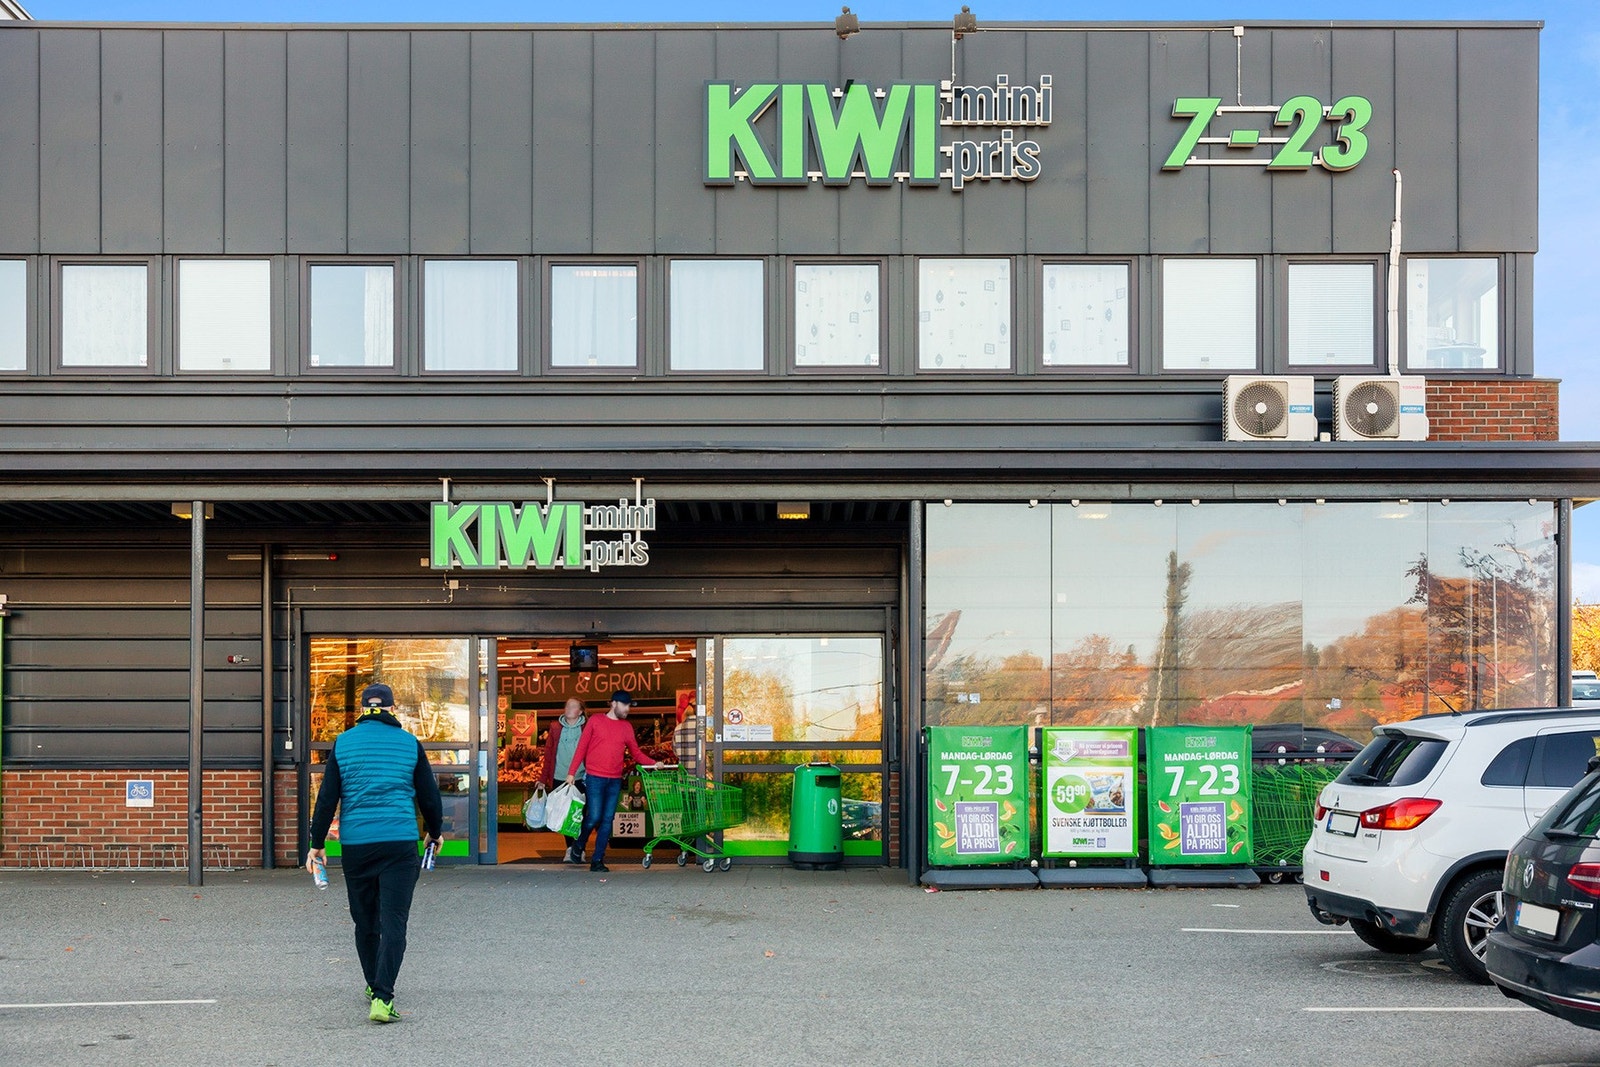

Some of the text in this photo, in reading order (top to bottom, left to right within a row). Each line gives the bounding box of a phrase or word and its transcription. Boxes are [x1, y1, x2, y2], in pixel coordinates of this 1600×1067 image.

[705, 74, 1053, 186] KIWI mini
[952, 129, 1041, 191] pris
[431, 498, 656, 569] KIWI mini
[590, 533, 649, 572] pris
[501, 671, 666, 696] FRUKT & GRØNT
[941, 751, 1013, 761] MANDAG-LØRDAG
[1164, 751, 1239, 762] MANDAG-LØRDAG
[941, 764, 1014, 796] 7-23
[1164, 764, 1241, 797] 7-23
[980, 813, 994, 823] OSS
[1052, 817, 1128, 827] SVENSKE KJØTTBOLLER
[1194, 814, 1206, 824] GIR
[1207, 813, 1221, 823] OSS
[961, 823, 995, 838] ALDRI
[1187, 823, 1222, 839] ALDRI
[961, 837, 973, 849] PÅ
[1187, 837, 1198, 850] PÅ
